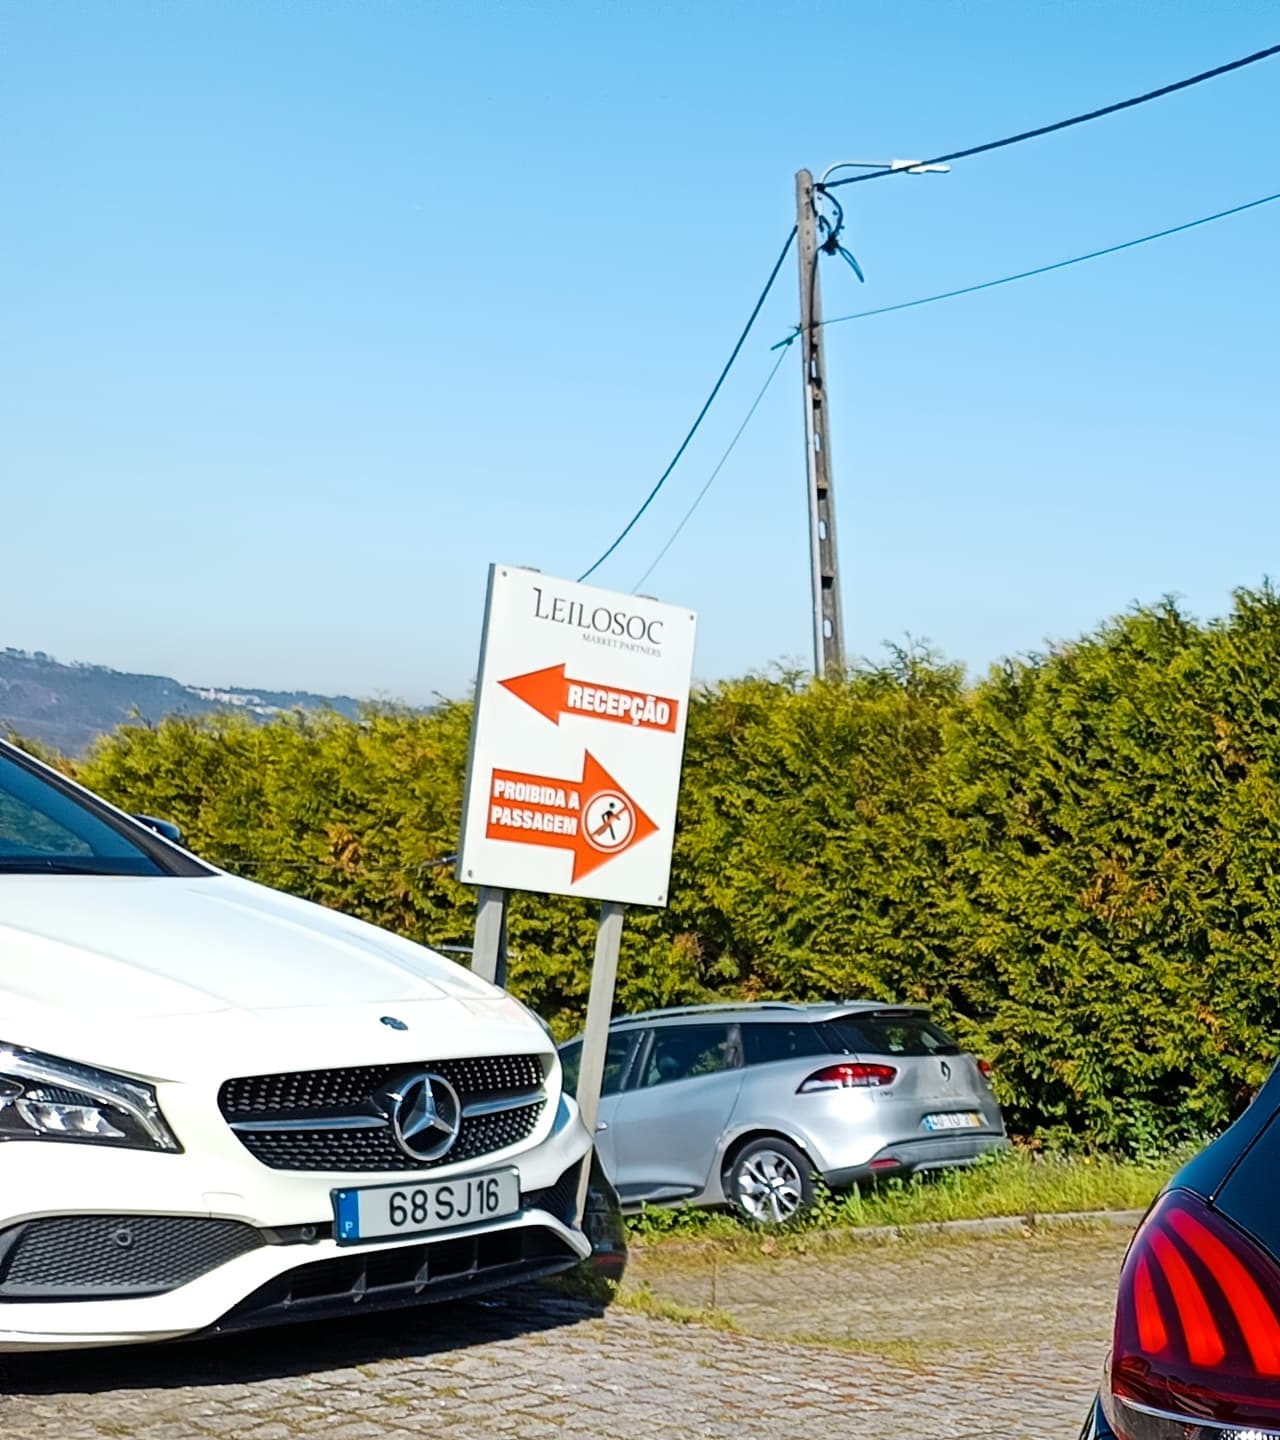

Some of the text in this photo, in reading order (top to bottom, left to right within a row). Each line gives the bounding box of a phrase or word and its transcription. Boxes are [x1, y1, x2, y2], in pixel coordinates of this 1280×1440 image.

[533, 587, 664, 645] LEILOSOC
[567, 685, 670, 727] RECEPÇÃO
[494, 779, 580, 810] PROIBIDA A
[491, 805, 578, 836] PASSAGEM
[345, 1221, 353, 1232] P
